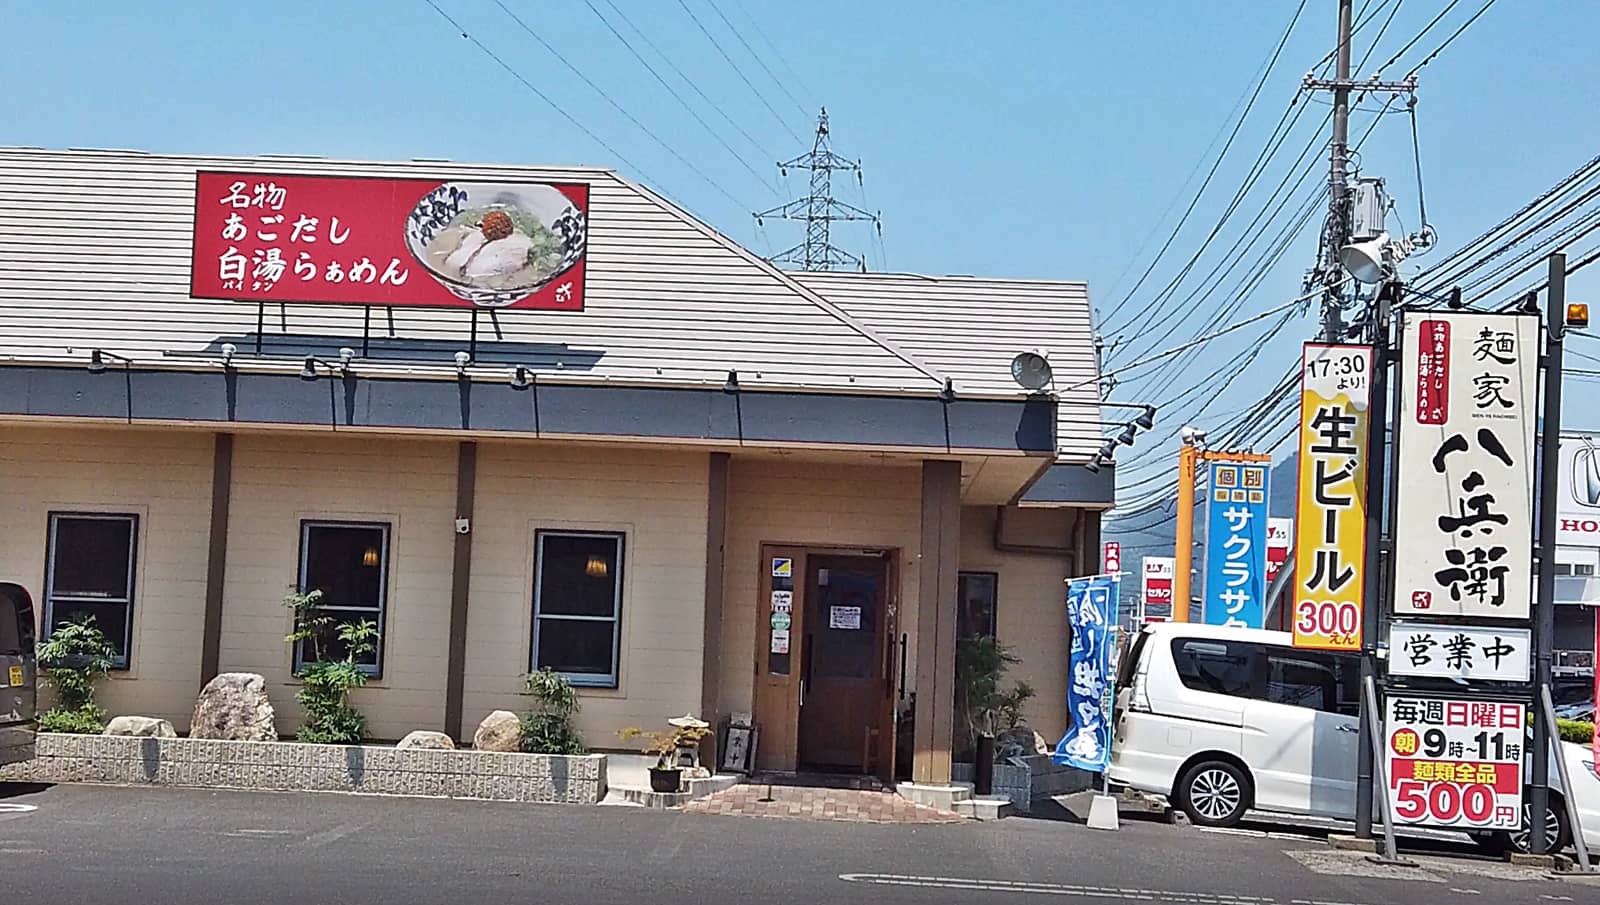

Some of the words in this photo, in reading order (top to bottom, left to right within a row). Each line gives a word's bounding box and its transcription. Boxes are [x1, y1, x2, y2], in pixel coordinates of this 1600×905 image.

[220, 181, 286, 210] 名物
[222, 212, 351, 243] あごだし
[219, 246, 408, 285] 白湯らぁめん
[1307, 355, 1365, 378] 17:30
[1472, 326, 1516, 408] 麺家
[1307, 407, 1358, 592] 生ビール
[1432, 428, 1513, 606] 八兵衛
[1560, 519, 1600, 532] HO
[1147, 588, 1171, 598] セルフ
[1297, 602, 1357, 634] 300
[1329, 632, 1355, 645] えん
[1404, 634, 1515, 671] 営業中
[1393, 700, 1521, 729] 毎週日曜日
[1395, 733, 1413, 753] 朝
[1414, 760, 1497, 785] 麺類全品
